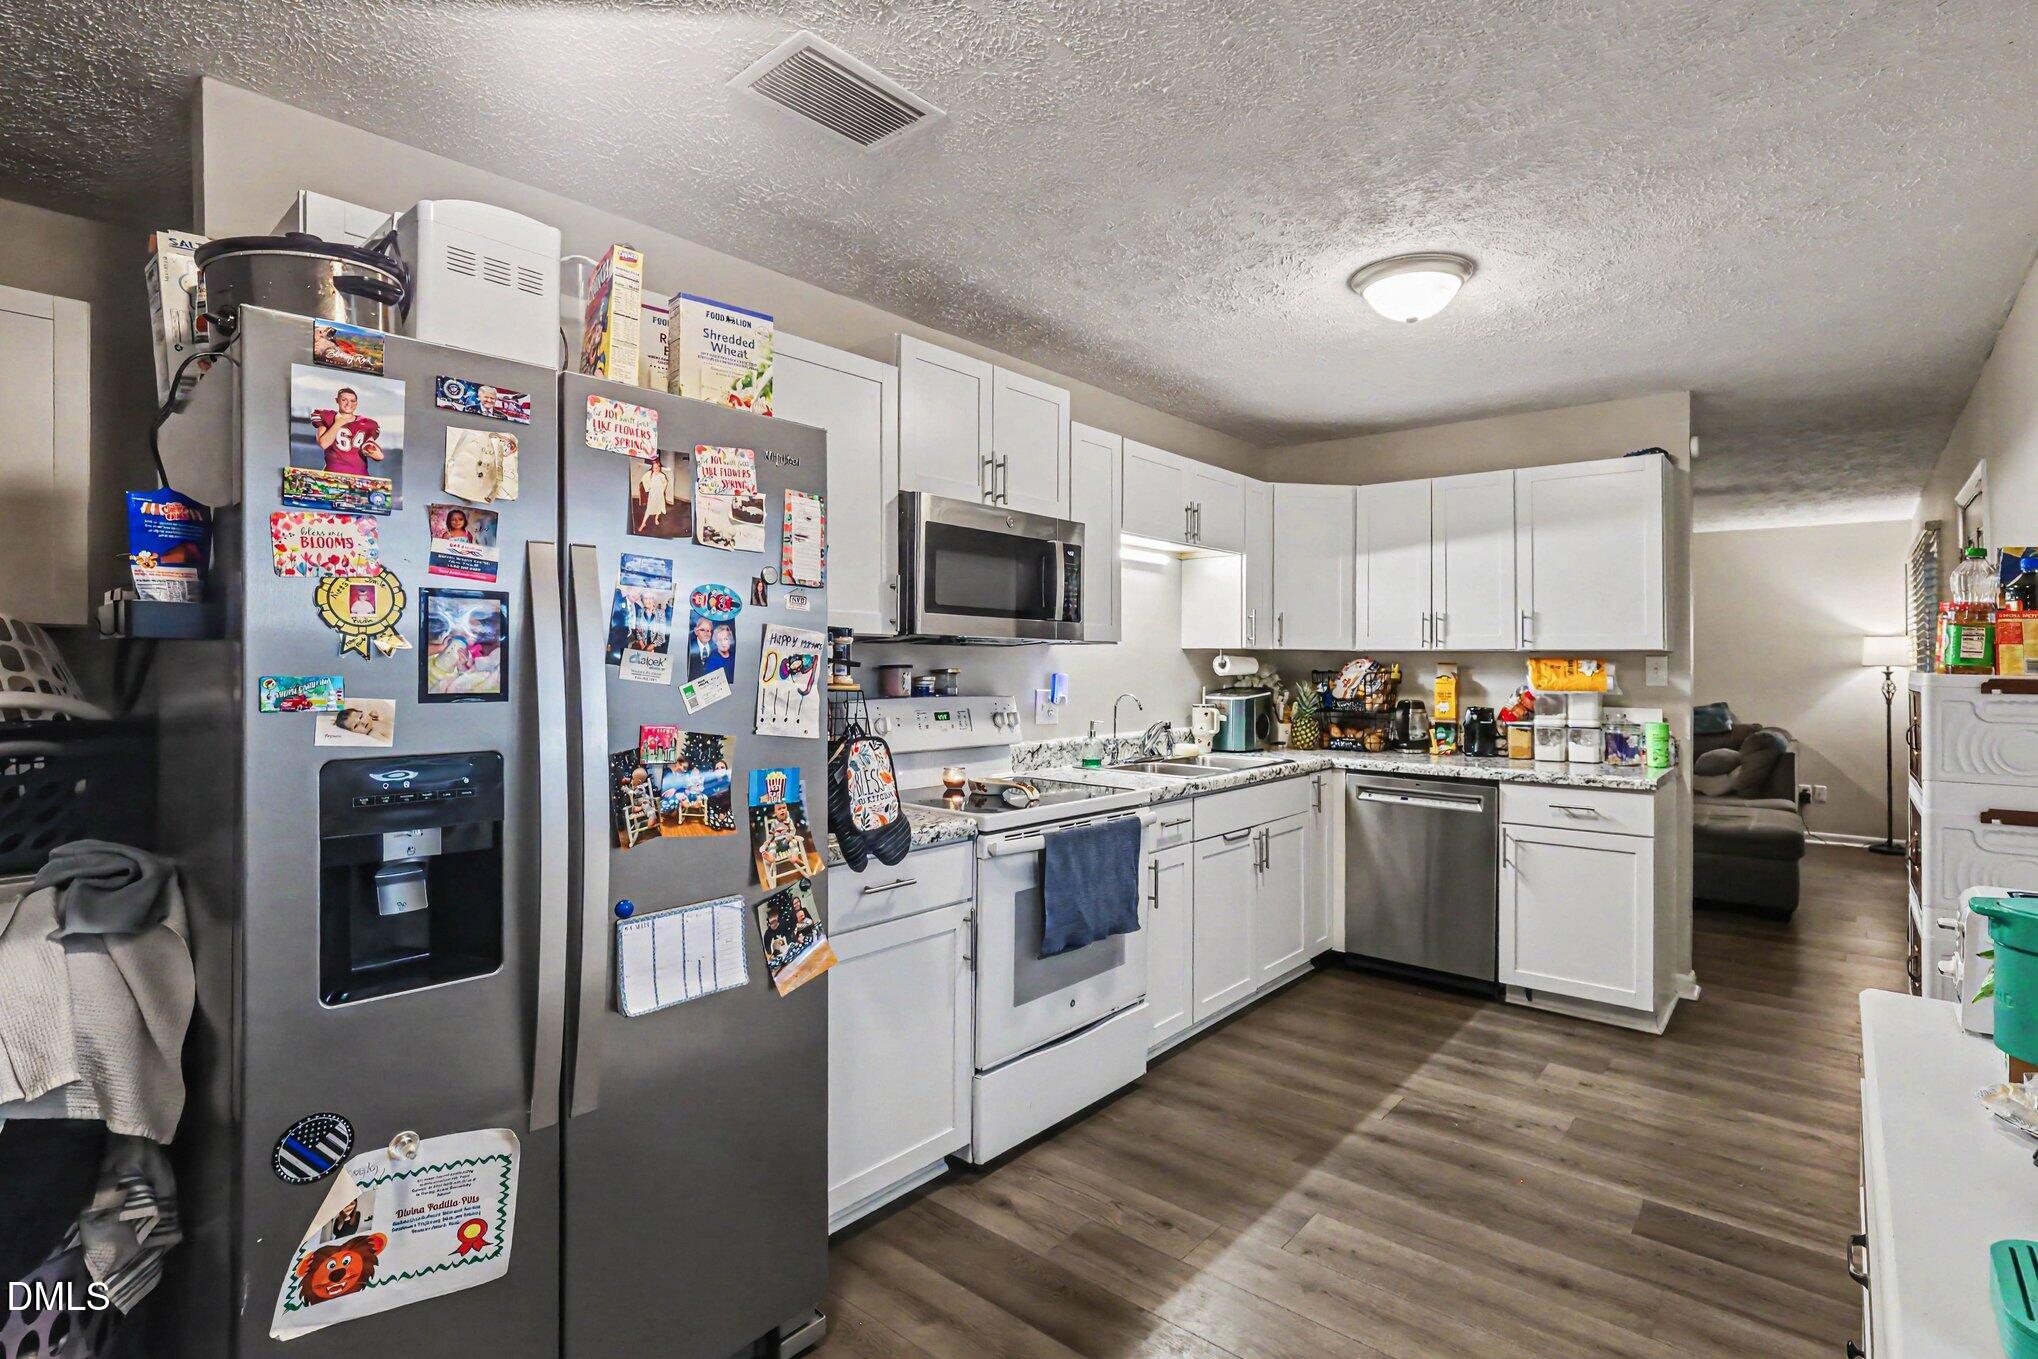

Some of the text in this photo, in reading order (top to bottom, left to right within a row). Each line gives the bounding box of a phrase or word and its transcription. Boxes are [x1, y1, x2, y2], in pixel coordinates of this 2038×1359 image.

[169, 237, 203, 249] SAL
[652, 316, 669, 326] FOO
[706, 311, 752, 329] FOOD LION
[703, 328, 755, 349] Shredded
[711, 341, 748, 359] Wheat
[300, 536, 354, 549] BLOOMS
